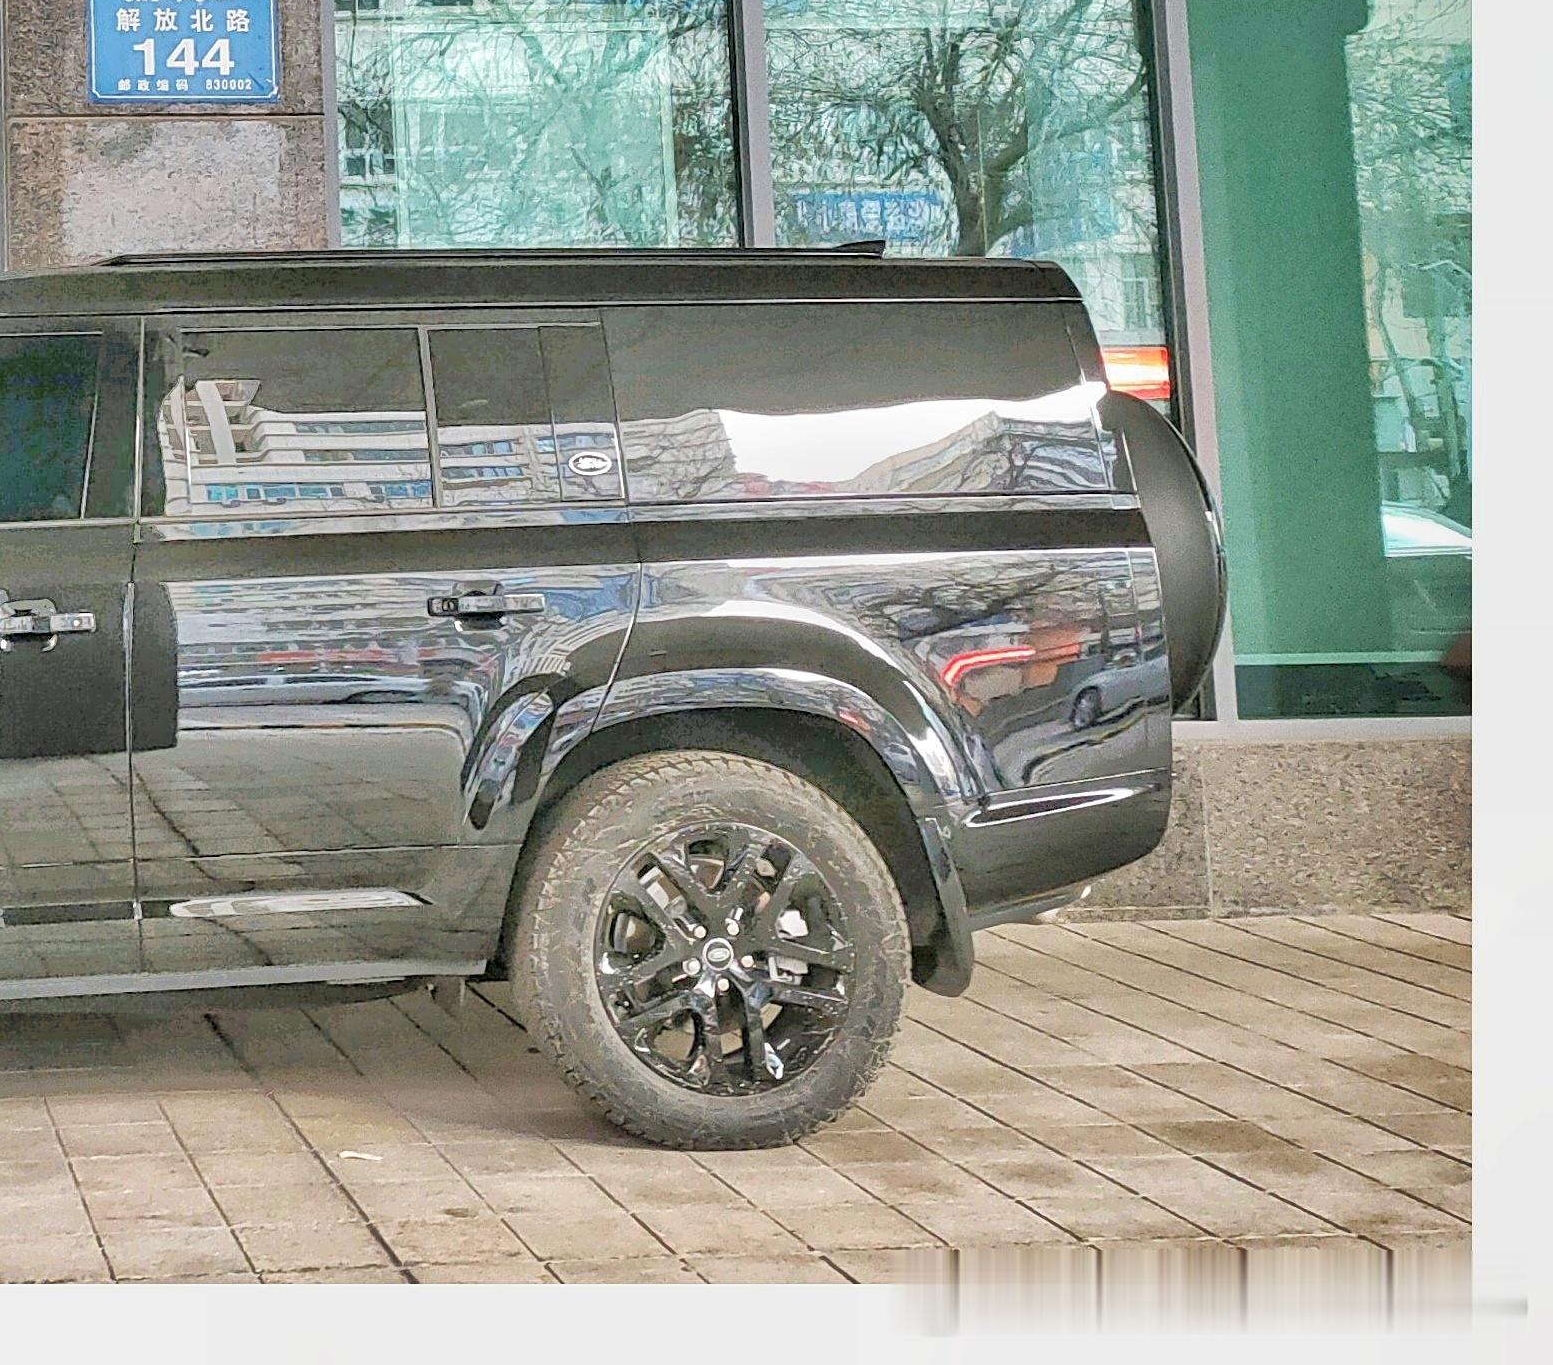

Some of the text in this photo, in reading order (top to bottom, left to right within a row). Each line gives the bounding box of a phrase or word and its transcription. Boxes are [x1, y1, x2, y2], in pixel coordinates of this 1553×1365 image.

[115, 8, 251, 32] 解放北路
[133, 38, 235, 76] 144
[117, 79, 253, 92] 邮政编码 830002
